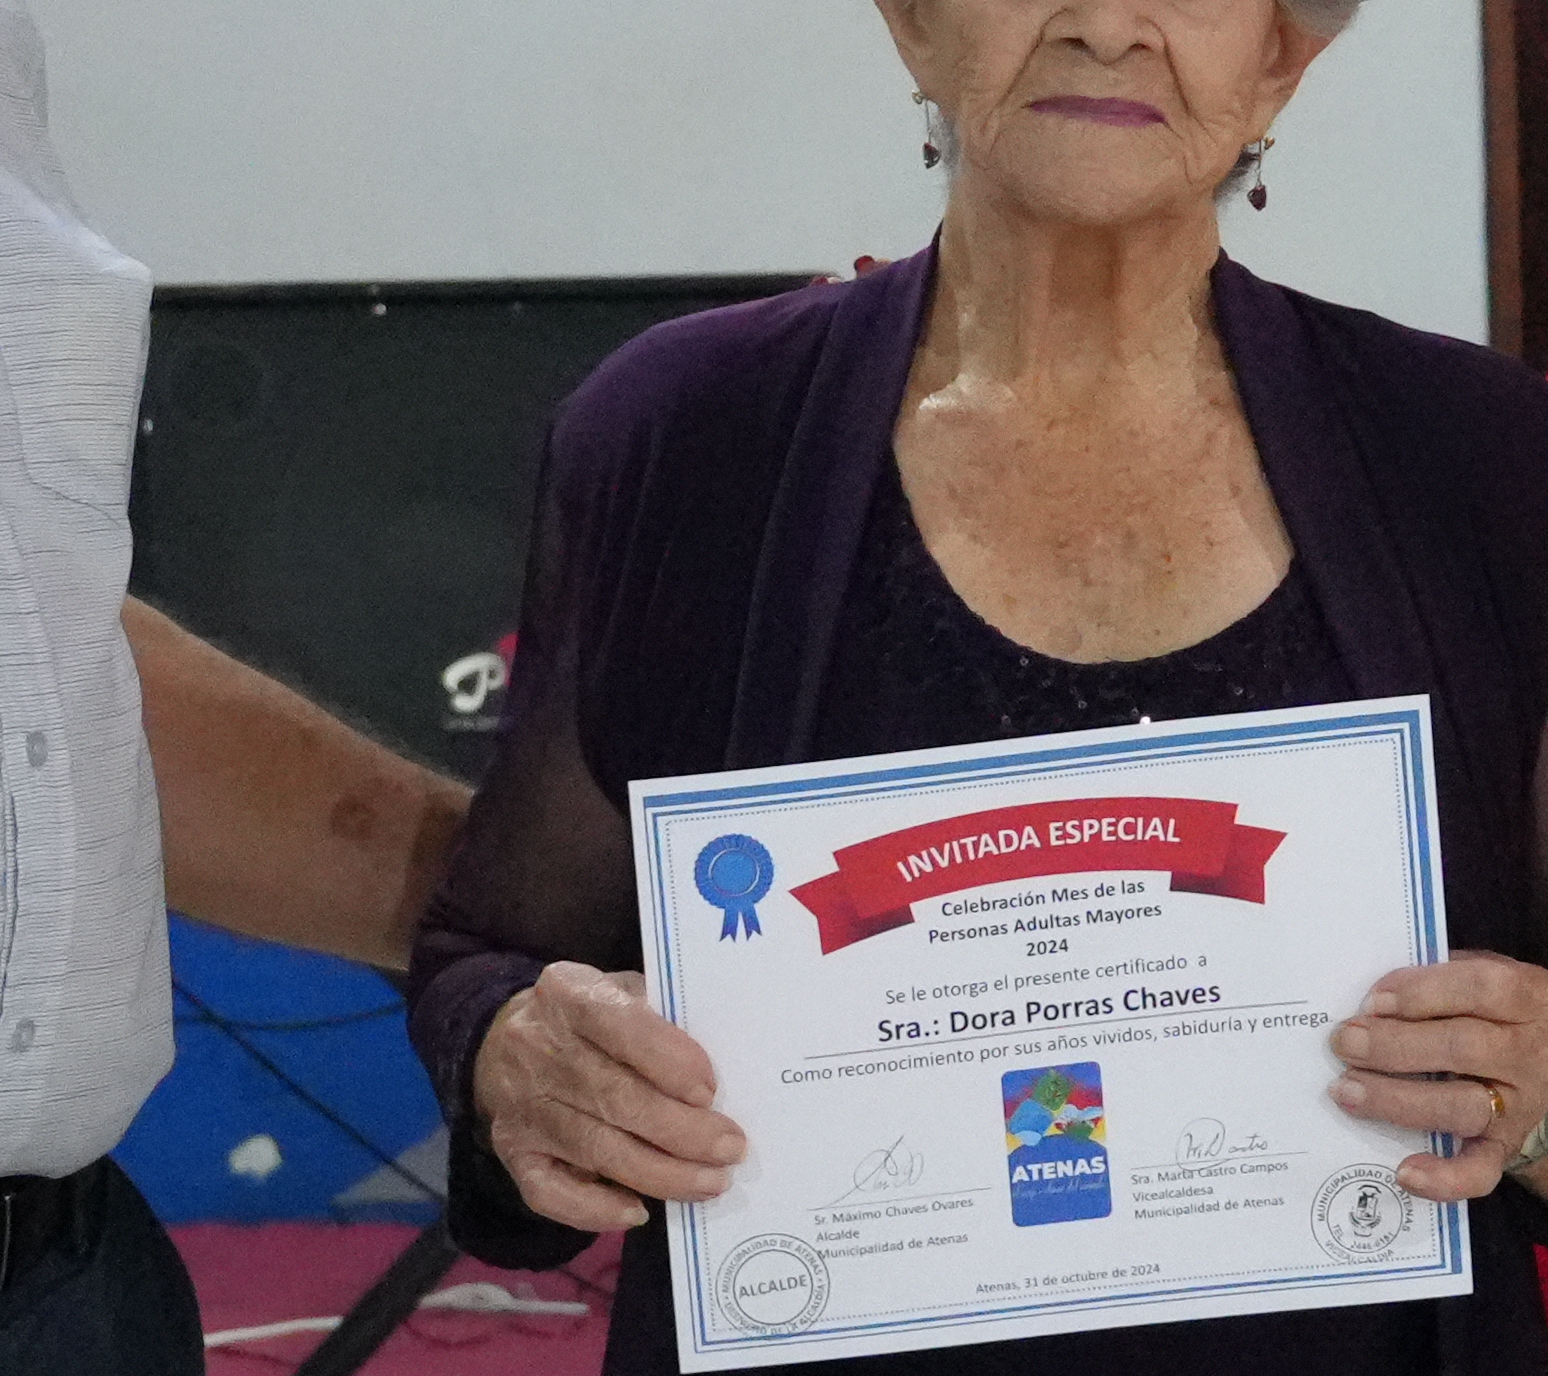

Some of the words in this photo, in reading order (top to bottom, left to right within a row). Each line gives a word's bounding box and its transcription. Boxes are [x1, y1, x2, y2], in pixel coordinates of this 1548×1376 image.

[896, 825, 1041, 882] INVITADA
[1049, 816, 1181, 846] ESPECIAL
[941, 891, 1046, 917] Celebración
[1052, 885, 1089, 904] Mes
[1094, 882, 1116, 899] de
[1121, 879, 1146, 896] las
[928, 920, 1009, 944] Personas
[1014, 913, 1081, 934] Adultas
[1086, 904, 1162, 927] Mayores
[1026, 938, 1069, 957] 2024
[885, 990, 906, 1005] Se
[911, 986, 927, 1002] le
[932, 981, 988, 998] otorga
[994, 974, 1008, 990] el
[1014, 967, 1090, 992] presente
[1096, 954, 1188, 979] certificado
[1198, 955, 1207, 967] a
[877, 1019, 940, 1042] Sra.:
[950, 1008, 1015, 1033] Dora
[1026, 995, 1114, 1023] Porras
[1123, 984, 1221, 1012] Chaves
[781, 1067, 833, 1084] Como
[837, 1050, 975, 1078] reconocimiento
[980, 1045, 1007, 1064] por
[1014, 1041, 1042, 1056] sus
[1047, 1034, 1088, 1051] años
[1092, 1026, 1157, 1046] vividos,
[1162, 1016, 1242, 1038] sabiduría
[1246, 1018, 1258, 1033] y
[1011, 1155, 1106, 1184] ATENAS
[1130, 1173, 1154, 1186] Sra.
[1157, 1170, 1194, 1182] Marta
[1198, 1165, 1237, 1178] Castro
[1240, 1160, 1289, 1175] Campos
[1132, 1185, 1214, 1203] Vicealcaldesa
[1134, 1201, 1220, 1220] Municipalidad
[1224, 1200, 1240, 1211] de
[1243, 1196, 1285, 1209] Atenas
[1317, 1168, 1383, 1222] MUNICIPALIDAD
[1397, 1188, 1414, 1232] ATENAS
[814, 1214, 829, 1226] Sr.
[832, 1209, 882, 1225] Máximo
[885, 1204, 929, 1218] Chaves
[932, 1197, 974, 1212] Ovares
[816, 1228, 860, 1243] Alcalde
[817, 1242, 905, 1261] Municipalidad
[908, 1237, 923, 1250] de
[927, 1233, 969, 1248] Atenas
[721, 1238, 778, 1293] MUNICIPALIDAD
[795, 1244, 824, 1276] ATENAS
[975, 1279, 1020, 1294] Atenas,
[1024, 1277, 1039, 1289] 31
[1042, 1274, 1058, 1286] de
[1060, 1268, 1109, 1284] octubre
[1112, 1266, 1127, 1279] de
[1131, 1263, 1161, 1276] 2024
[738, 1274, 809, 1299] ALCALDE
